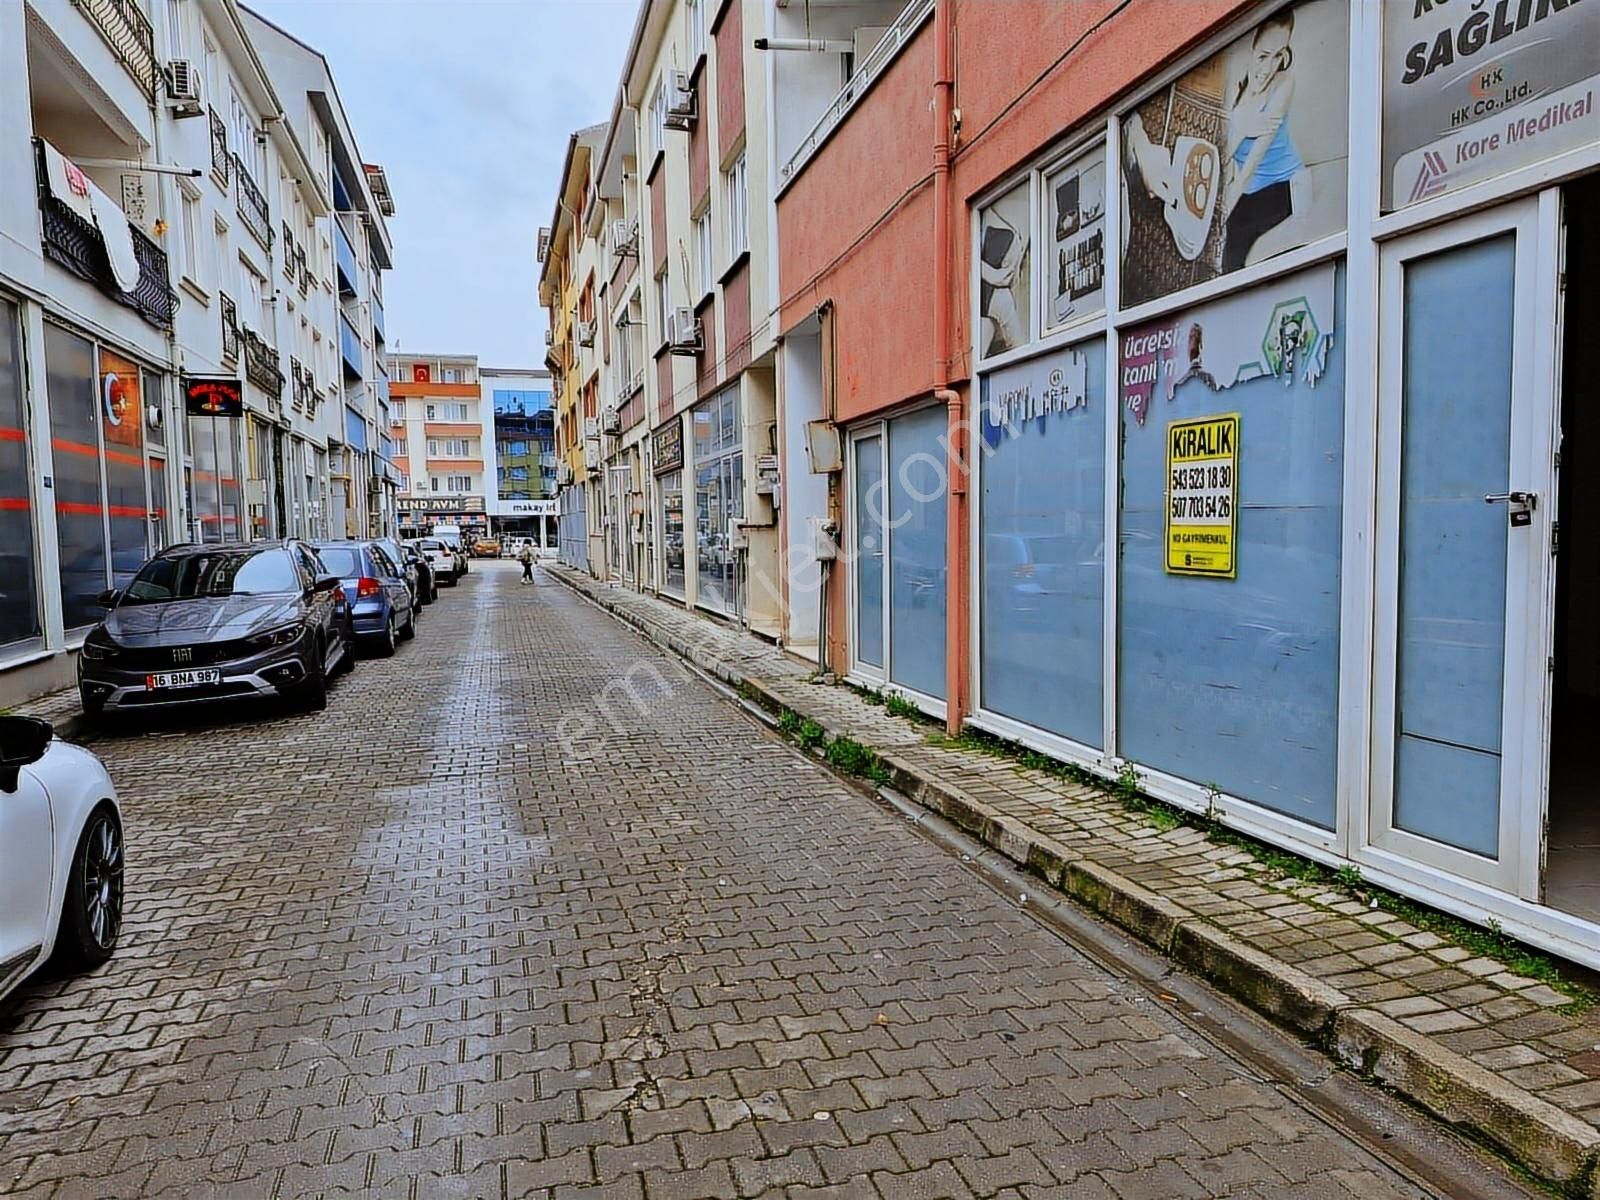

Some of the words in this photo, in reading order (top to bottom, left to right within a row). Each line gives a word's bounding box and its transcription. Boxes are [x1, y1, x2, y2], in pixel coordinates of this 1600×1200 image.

[1401, 0, 1582, 84] SAĞLI
[1451, 106, 1470, 127] HK
[1456, 132, 1500, 164] Kore
[1506, 91, 1593, 145] Medikal
[1172, 469, 1187, 490] 543
[1189, 467, 1204, 490] 523
[1207, 466, 1218, 489] 18
[1219, 465, 1231, 488] 30
[432, 500, 459, 510] AVM
[1171, 497, 1187, 518] 507
[1189, 496, 1204, 517] 703
[1205, 495, 1217, 517] 54
[1218, 495, 1230, 517] 26
[173, 647, 193, 663] FIAT
[154, 675, 166, 687] 16
[171, 673, 195, 685] BNA
[197, 670, 219, 682] 987
